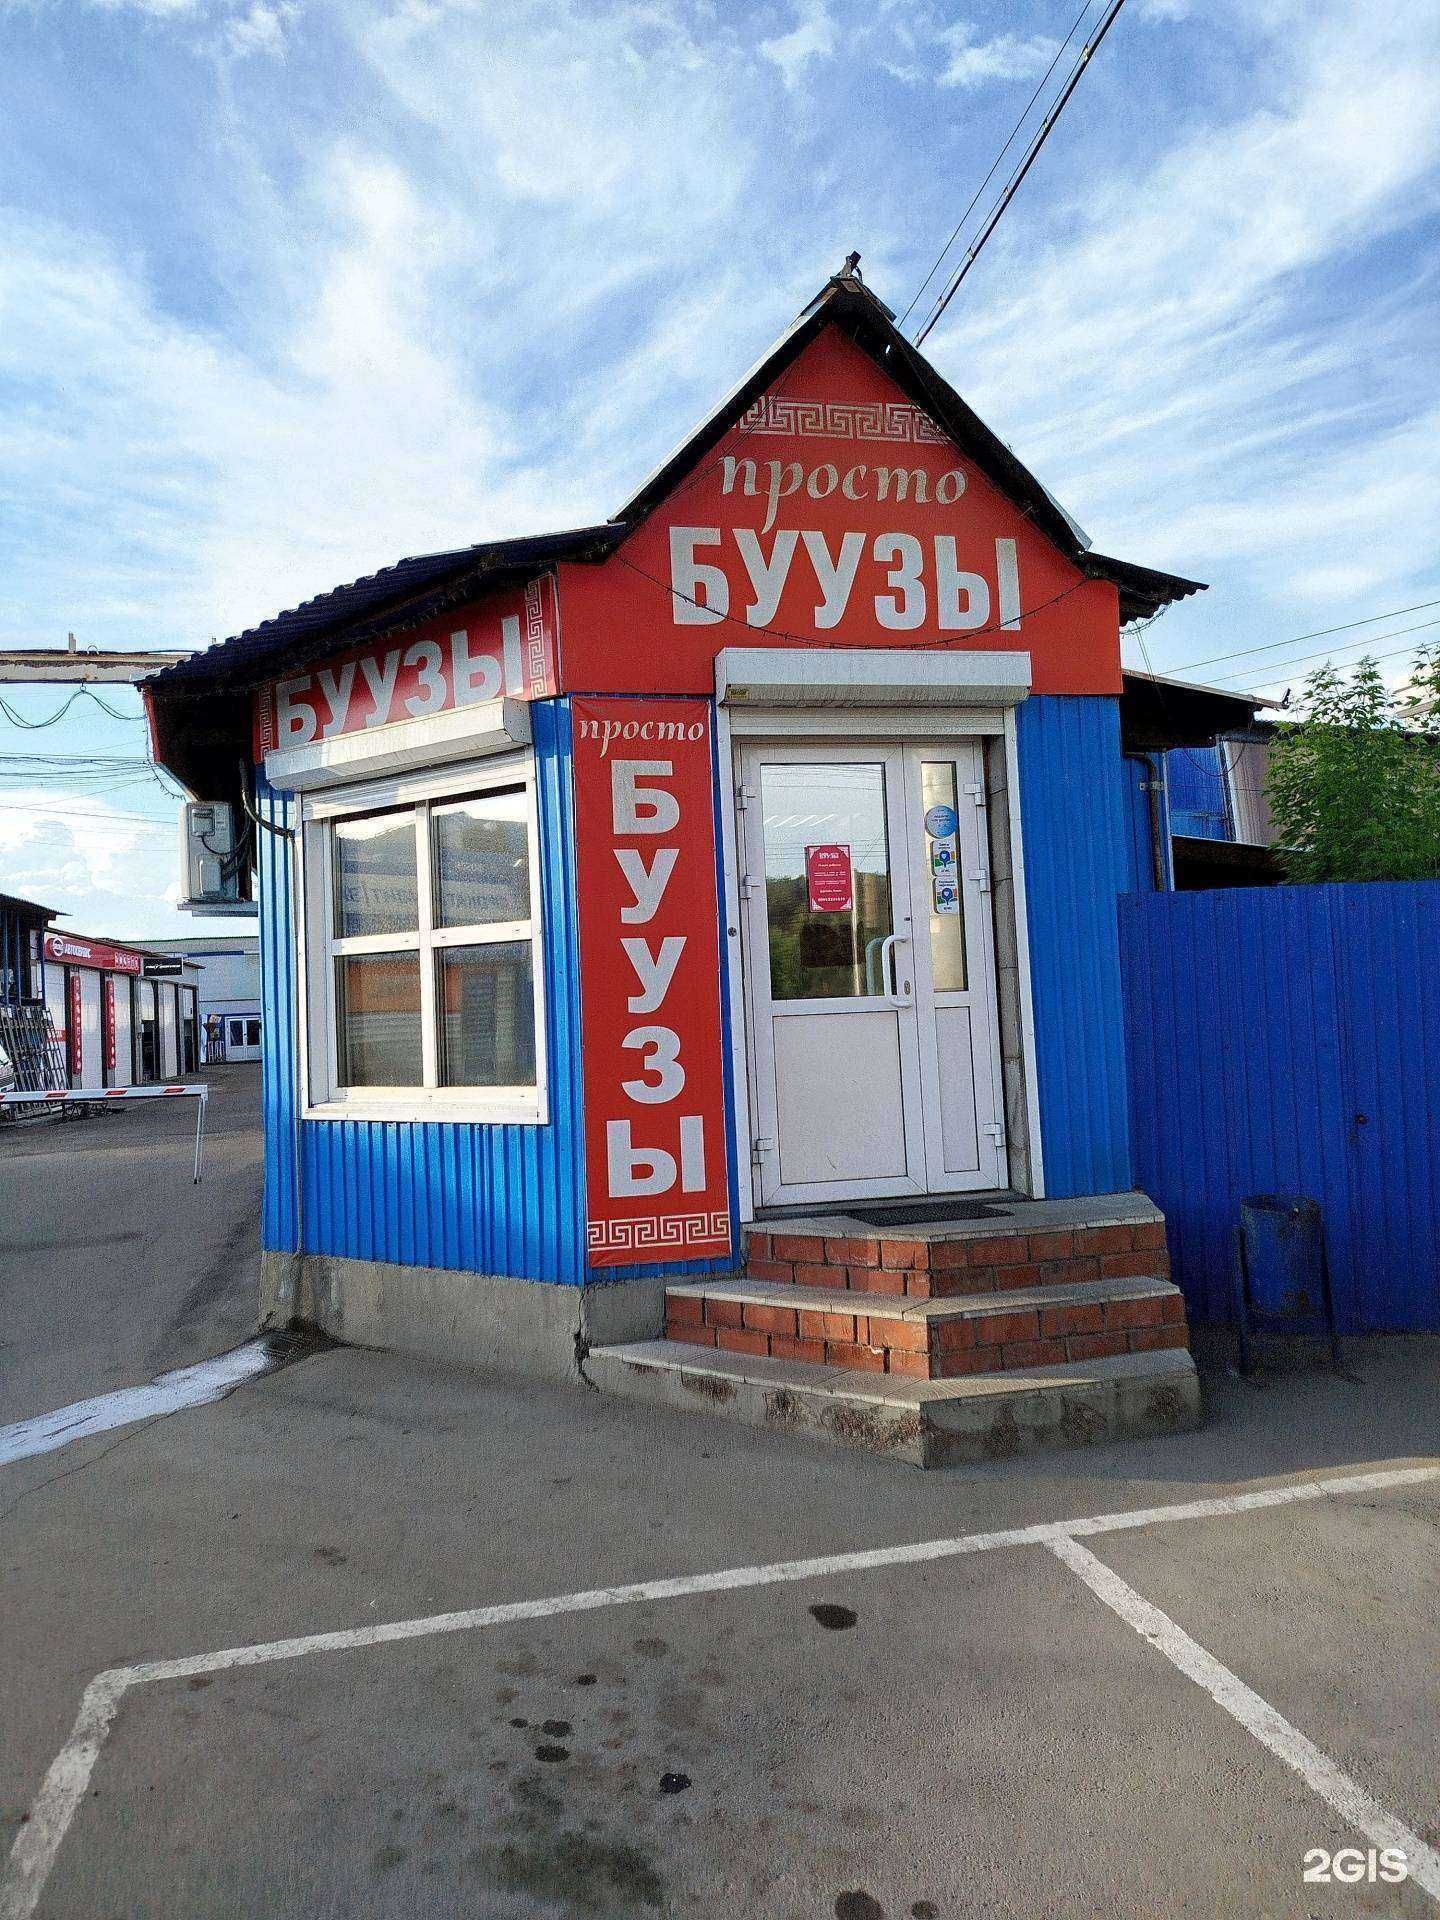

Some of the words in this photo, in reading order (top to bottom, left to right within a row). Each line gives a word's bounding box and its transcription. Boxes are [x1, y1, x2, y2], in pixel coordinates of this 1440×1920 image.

[722, 456, 968, 534] просто
[669, 526, 1021, 631] БУУЗЫ
[275, 614, 523, 751] БУУЗЫ
[579, 717, 704, 758] просто
[605, 760, 706, 1197] БУУЗЫ
